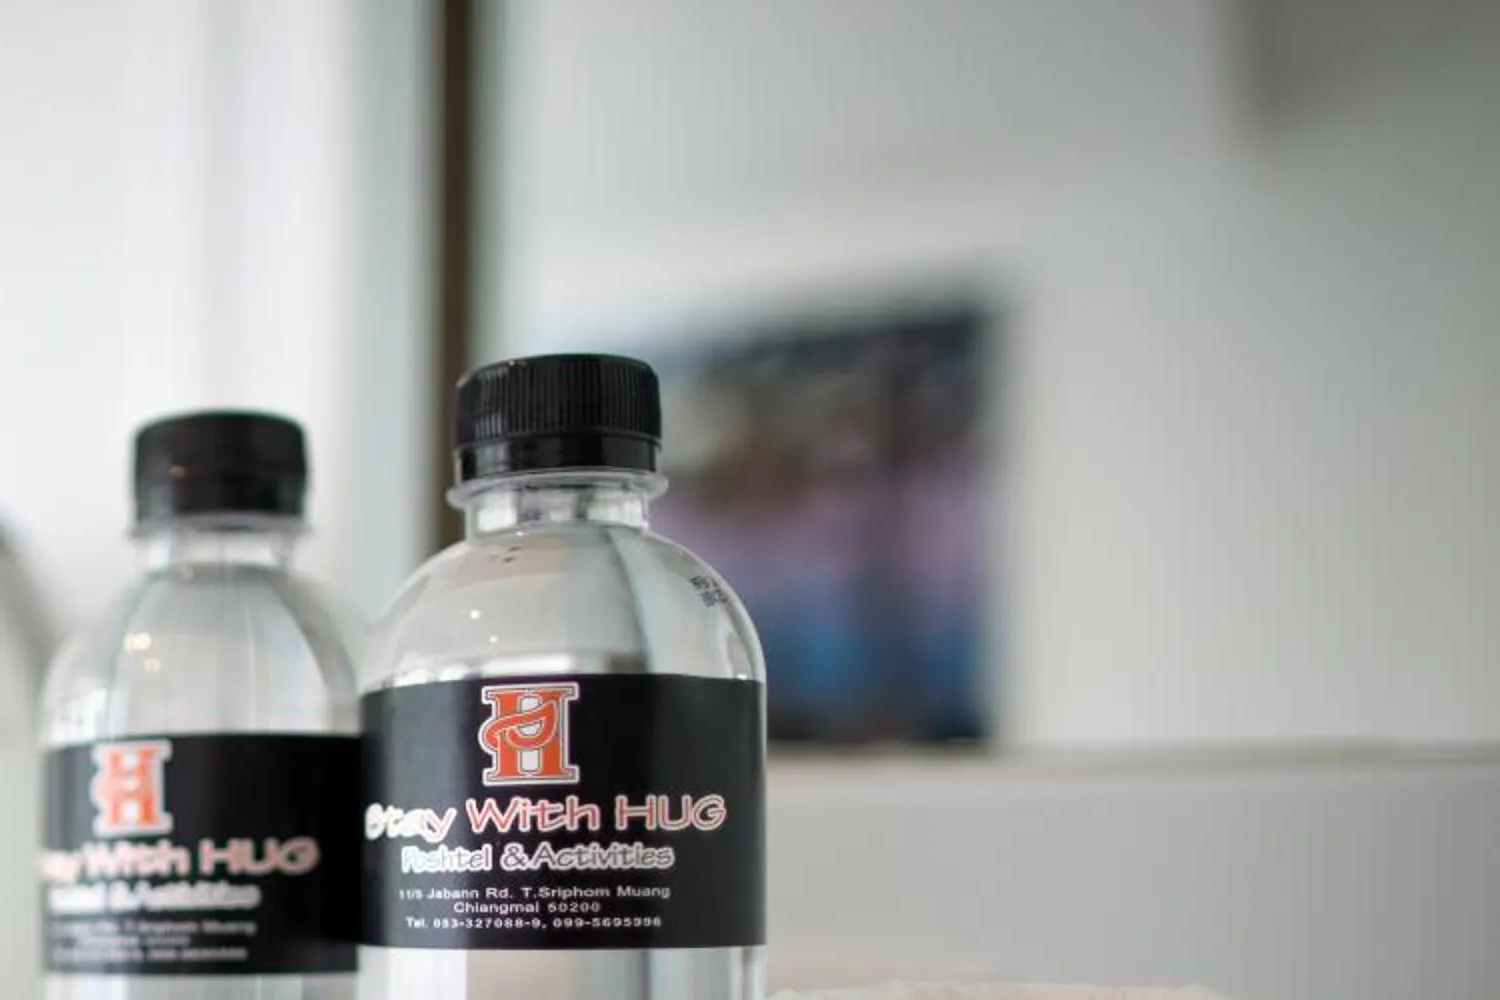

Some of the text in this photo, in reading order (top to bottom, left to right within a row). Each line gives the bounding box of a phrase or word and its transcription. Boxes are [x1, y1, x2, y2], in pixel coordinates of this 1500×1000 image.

[465, 796, 601, 833] With
[614, 795, 727, 832] HUG
[198, 836, 320, 876] HUG
[485, 886, 514, 900] Rd.
[616, 884, 671, 899] Muang
[453, 901, 601, 915] Chiangmai 50200
